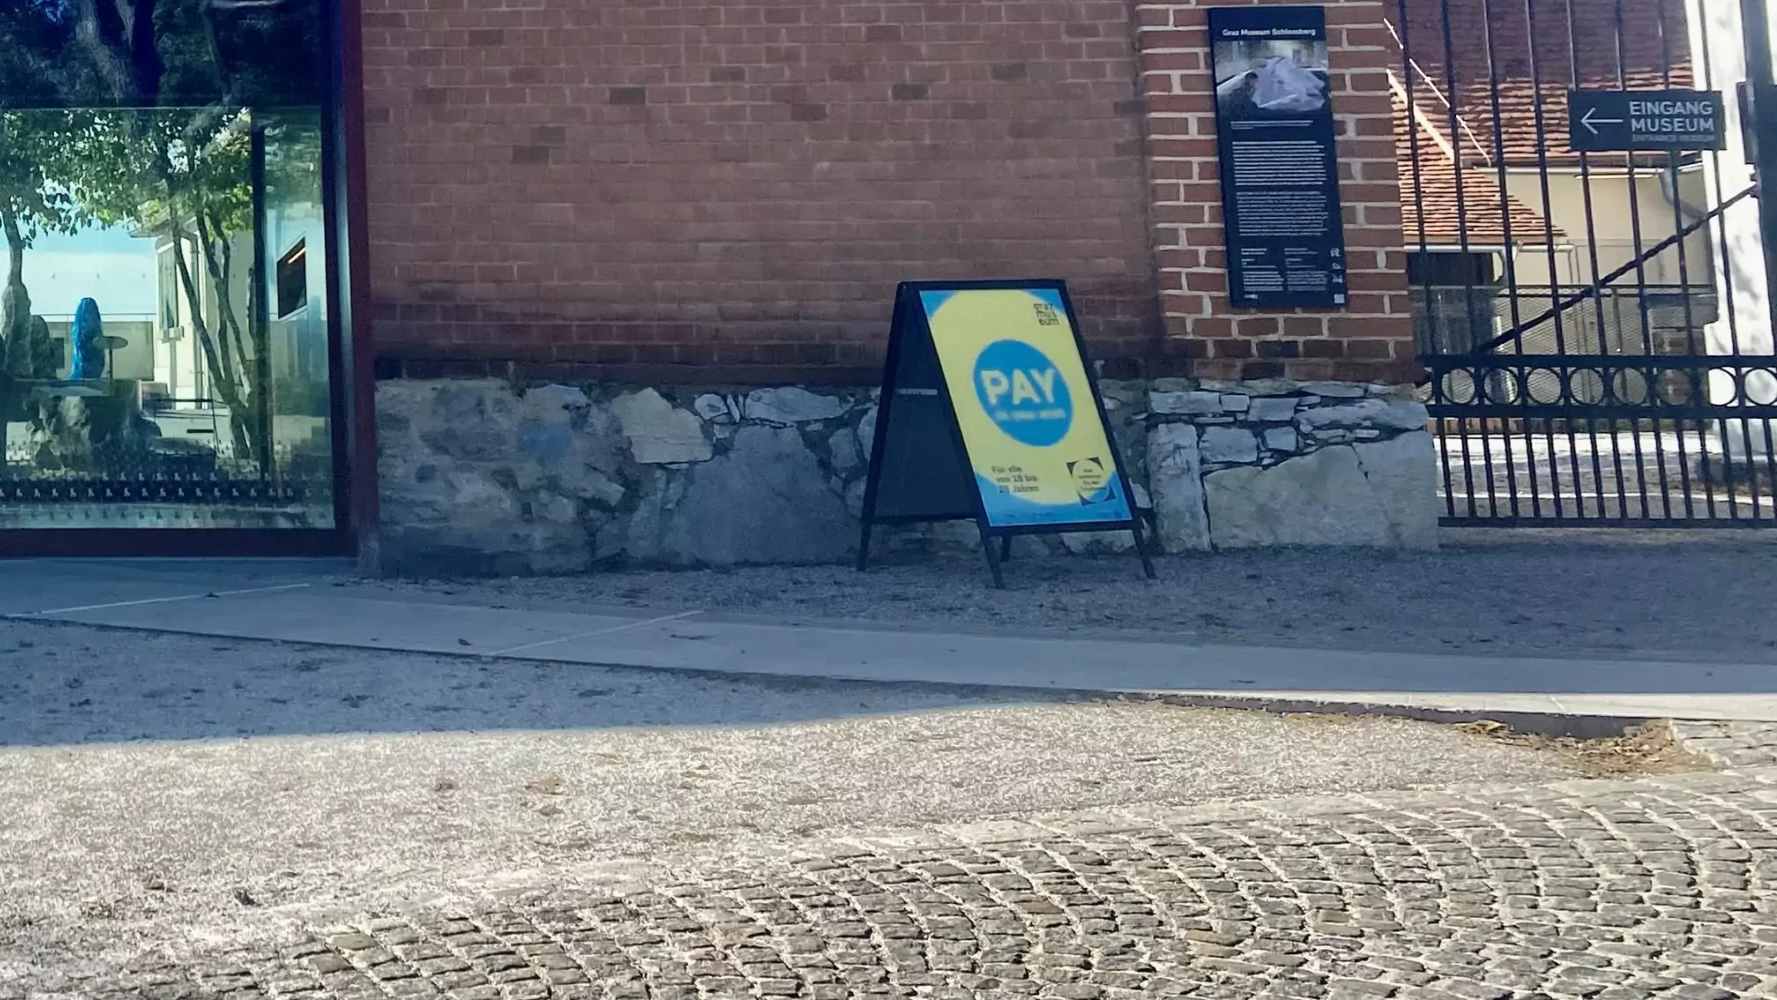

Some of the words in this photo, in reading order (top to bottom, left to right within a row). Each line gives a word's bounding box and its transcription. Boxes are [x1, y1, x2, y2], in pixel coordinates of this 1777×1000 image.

[1629, 101, 1713, 115] EINGANG
[1631, 118, 1714, 132] MUSEUM
[980, 368, 1055, 405] PAY
